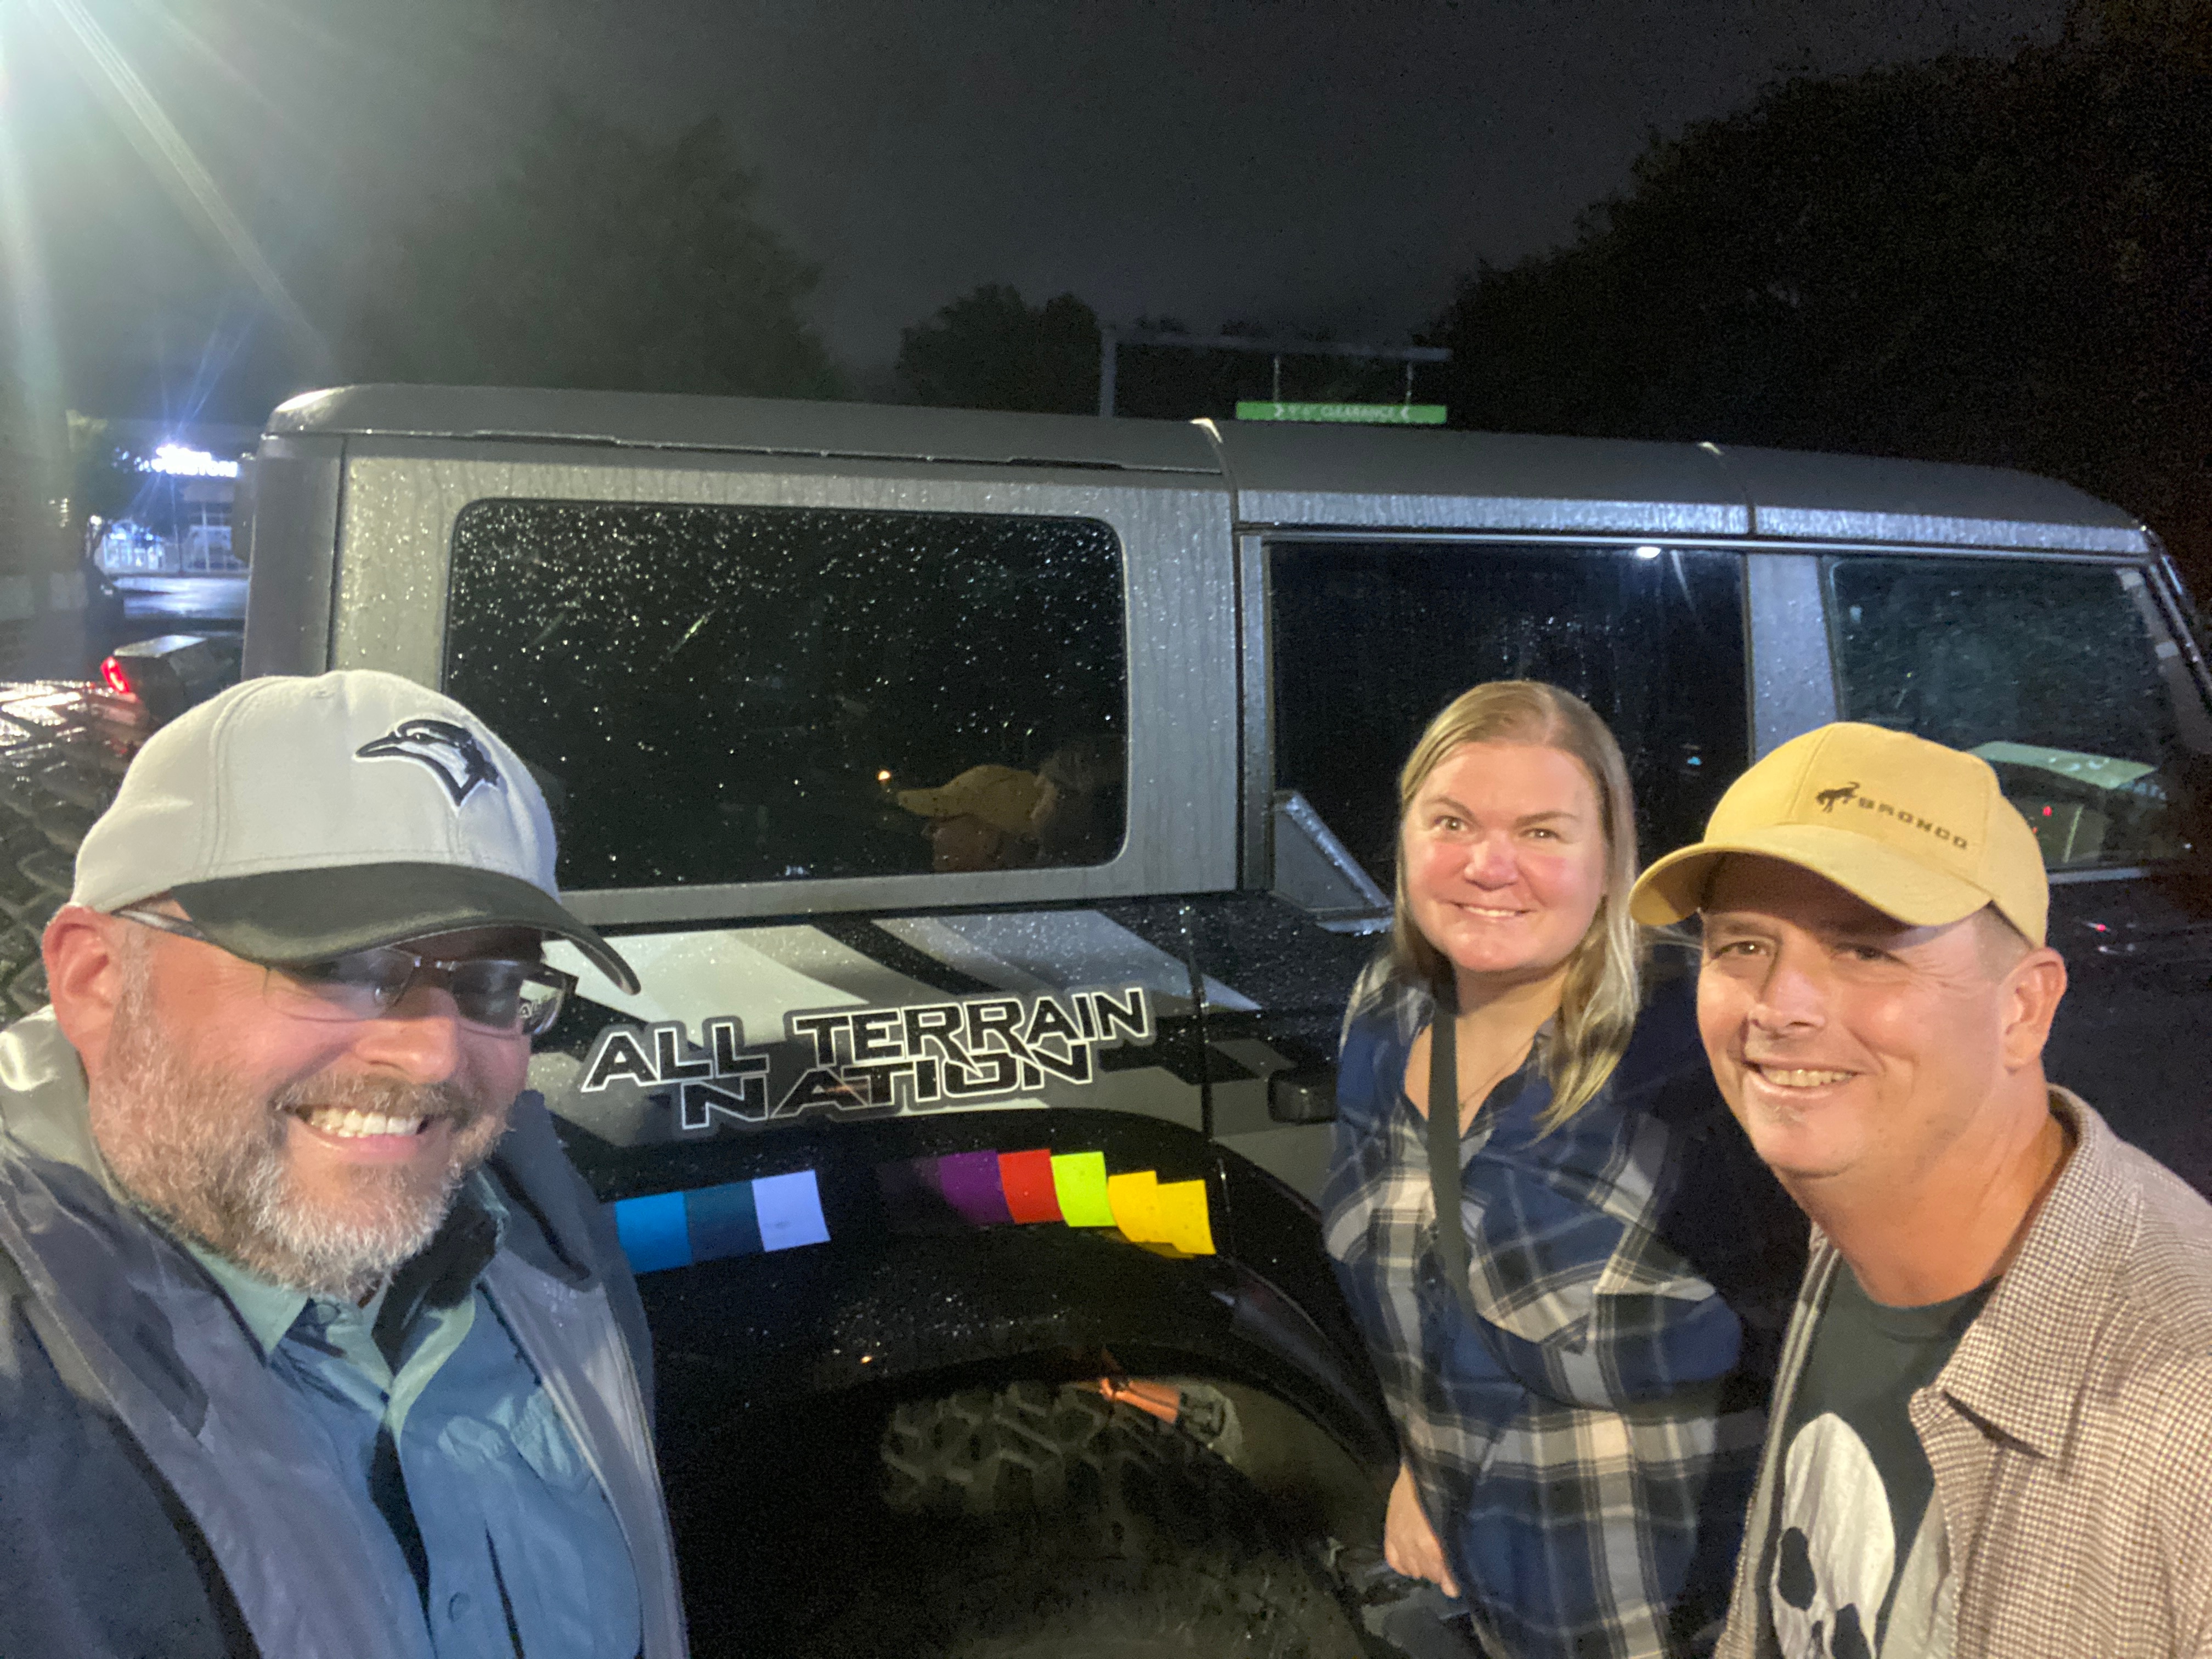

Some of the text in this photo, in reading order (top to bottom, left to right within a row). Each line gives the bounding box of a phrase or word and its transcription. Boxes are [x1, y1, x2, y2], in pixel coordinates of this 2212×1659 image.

[1321, 405, 1396, 418] CLEARANCE
[1859, 797, 1968, 850] BRONCO
[580, 988, 1151, 1093] ALL TERRAIN
[681, 1040, 1092, 1130] NATION
